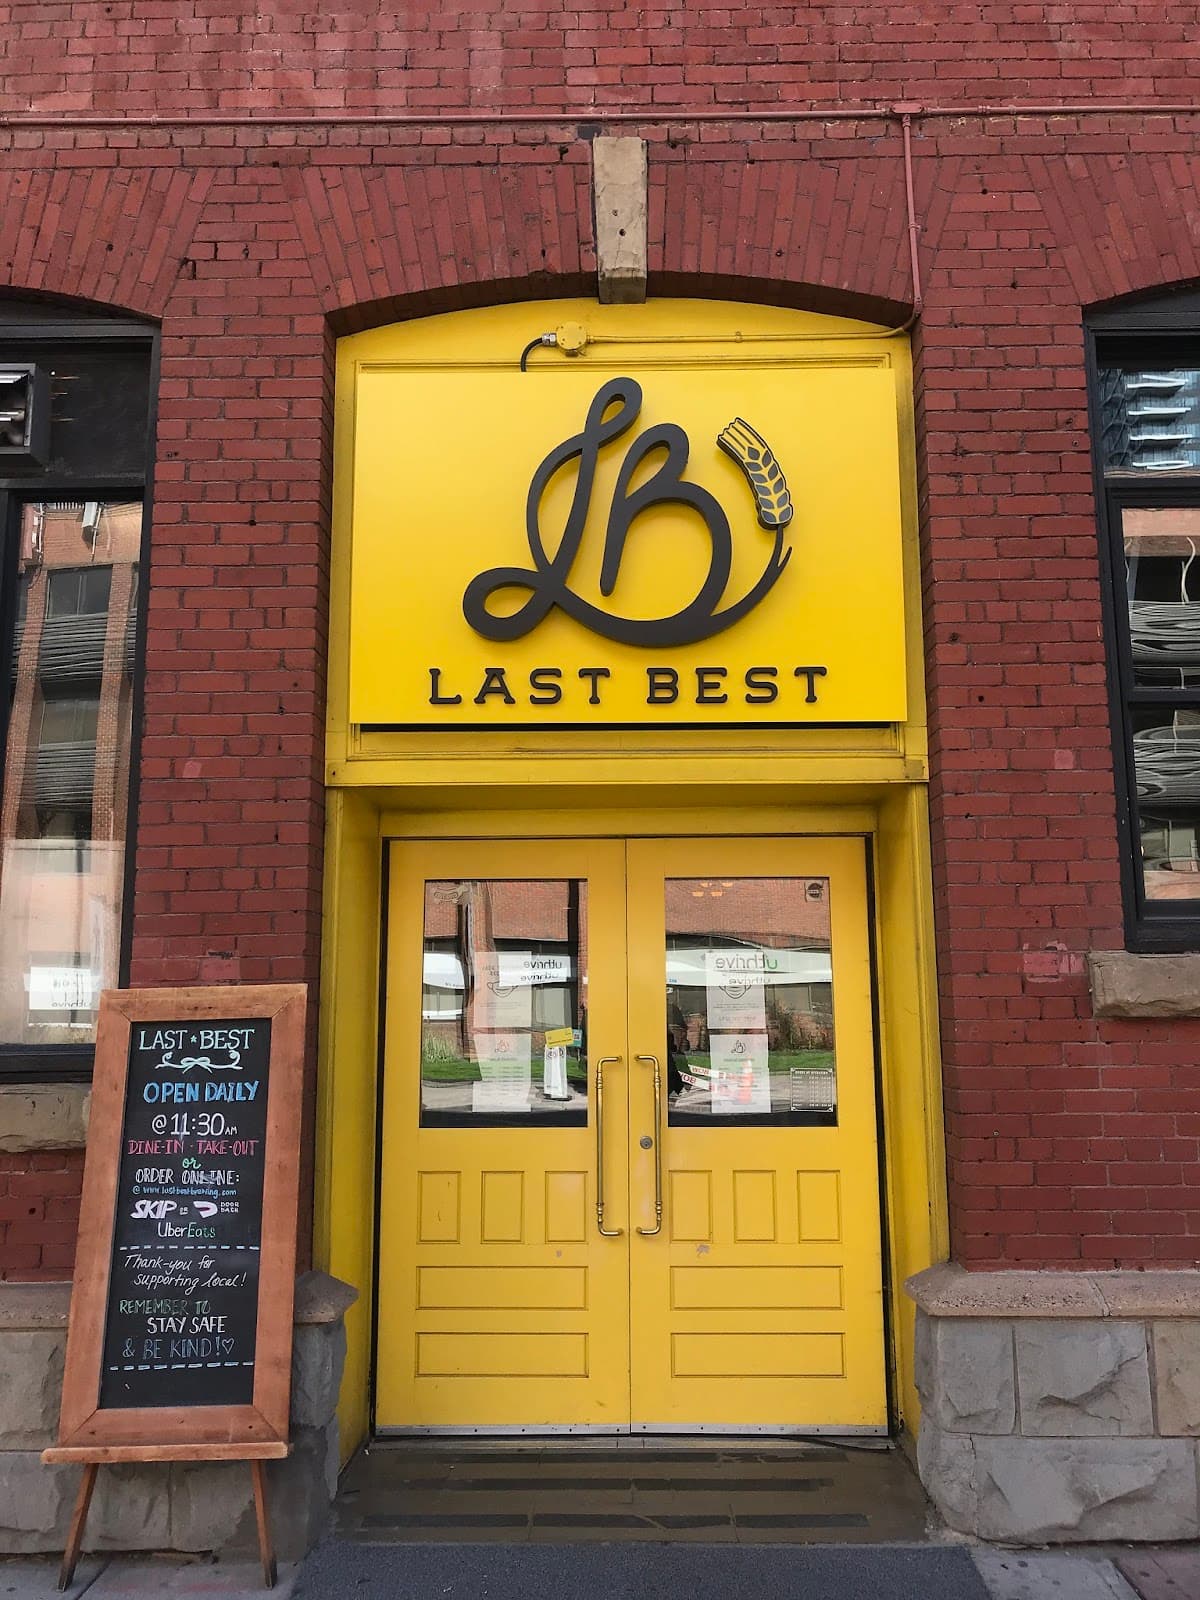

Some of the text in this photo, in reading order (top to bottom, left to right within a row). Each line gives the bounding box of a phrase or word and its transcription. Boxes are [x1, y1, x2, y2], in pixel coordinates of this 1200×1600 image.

[429, 666, 827, 705] LAST BEST
[138, 1028, 255, 1050] LAST BEST
[143, 1080, 260, 1104] OPEN DAILY
[128, 1139, 259, 1157] DINE-IN TAKE-OUT
[182, 1157, 201, 1169] or
[135, 1168, 174, 1184] ORDER
[130, 1200, 177, 1219] SKIP
[124, 1253, 215, 1274] Thank-you for
[133, 1272, 246, 1295] supporting local!
[119, 1299, 211, 1315] REMEMBER TO
[147, 1315, 228, 1334] STAY SAFE
[122, 1336, 221, 1359] & BE KIND!
